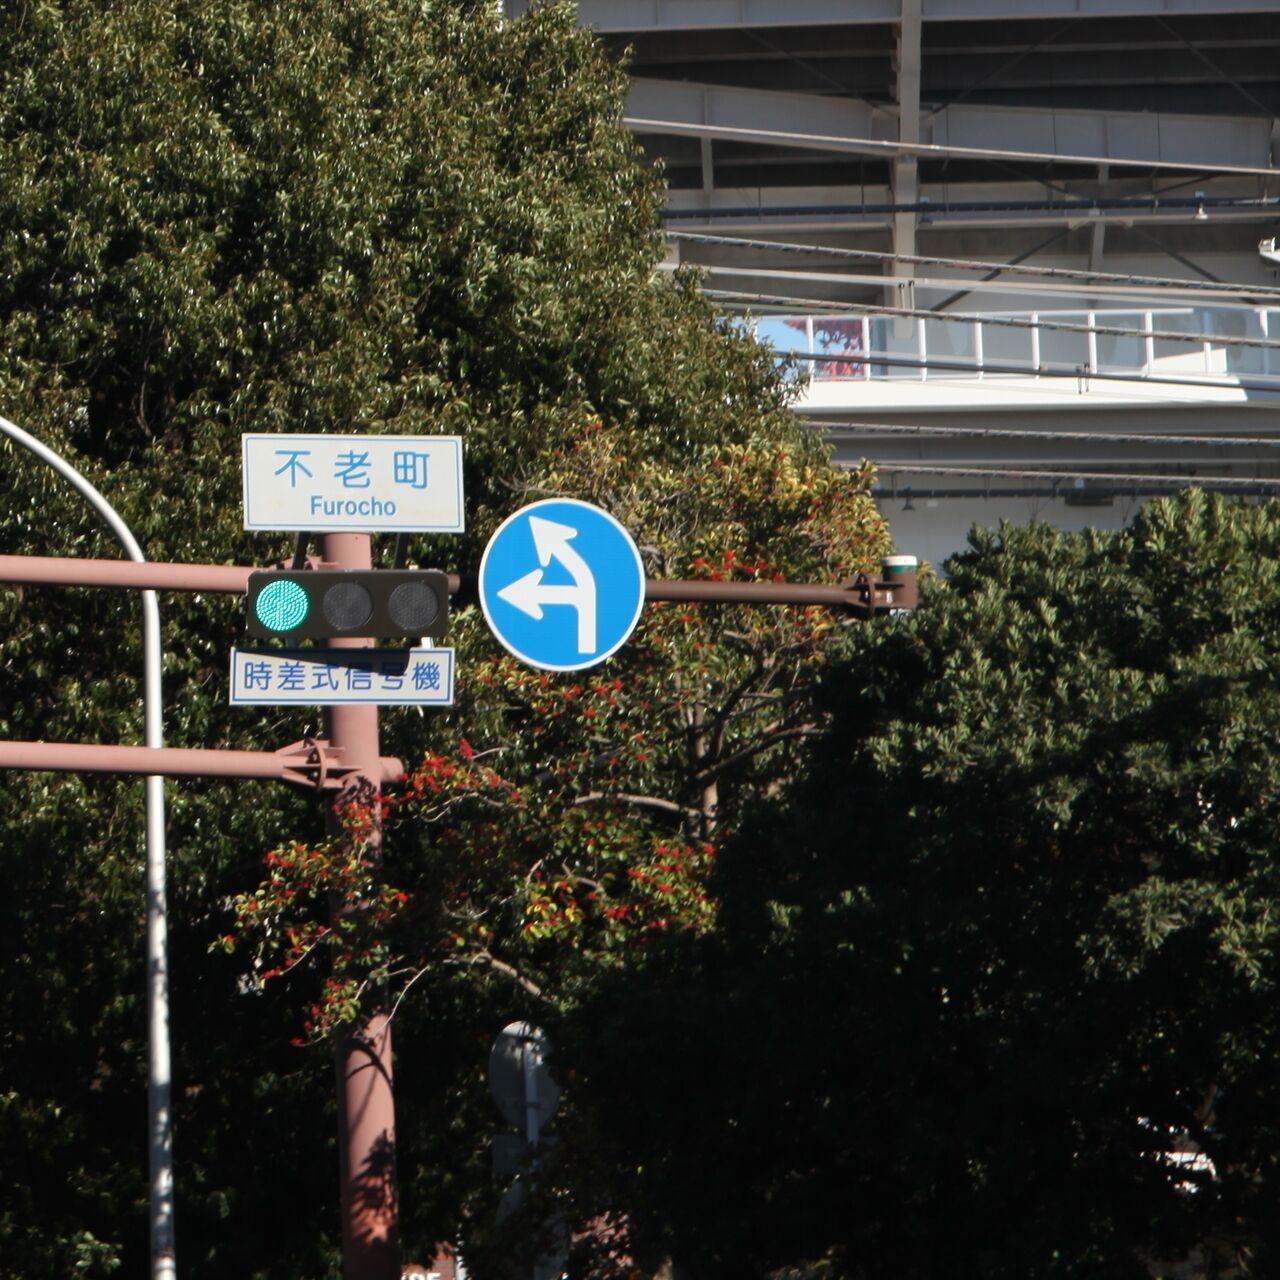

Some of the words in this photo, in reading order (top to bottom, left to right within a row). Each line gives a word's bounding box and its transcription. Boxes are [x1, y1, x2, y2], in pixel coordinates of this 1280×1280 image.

[274, 449, 430, 489] 不老町
[310, 495, 397, 516] Furocho
[243, 661, 441, 691] 時差式信号機
